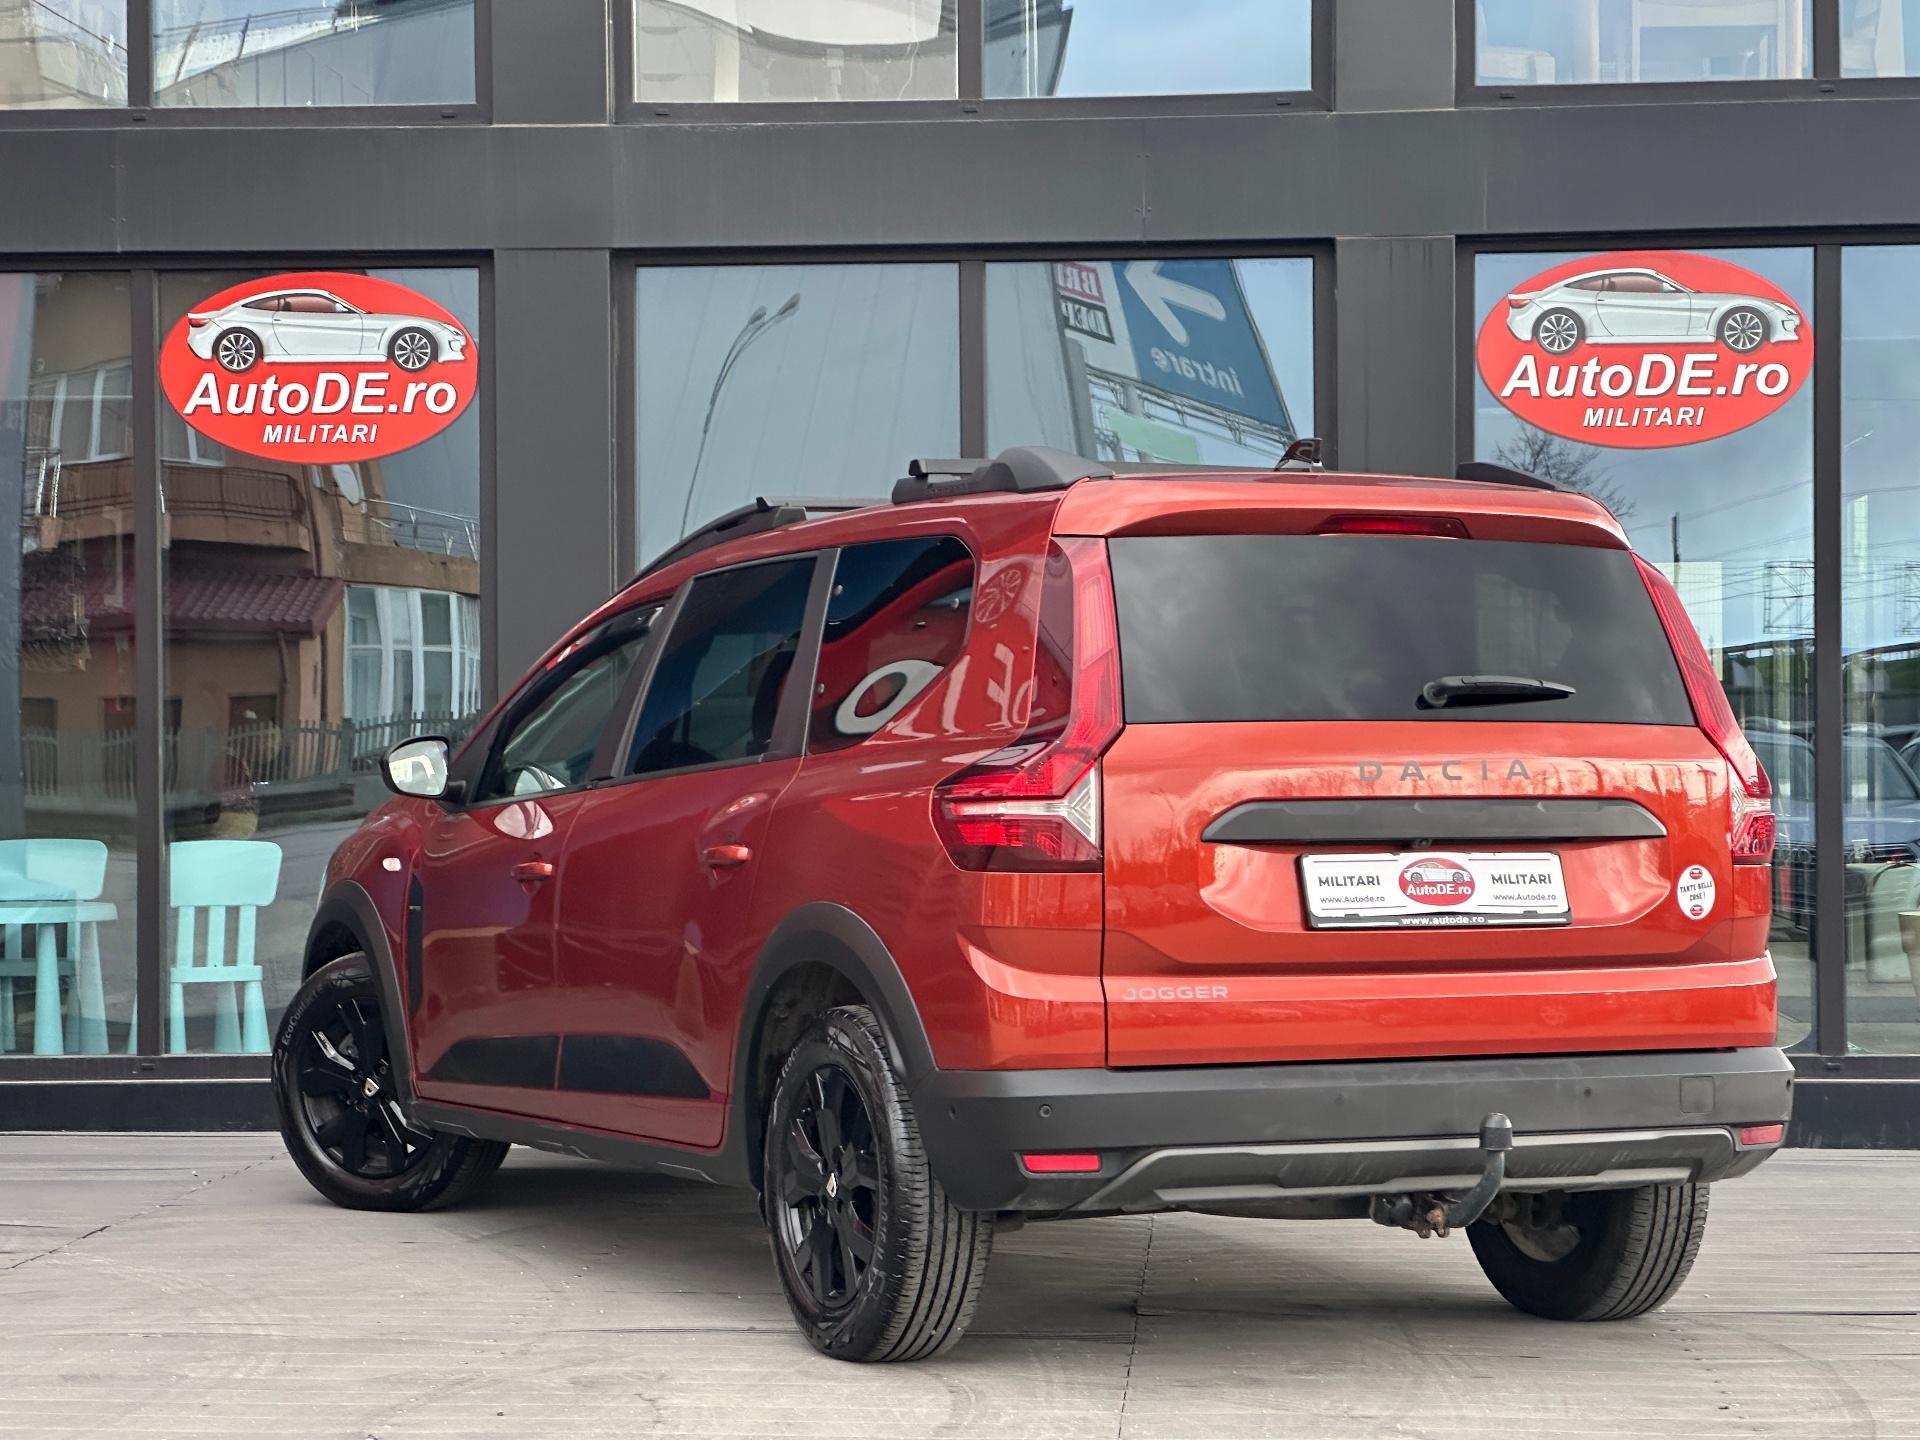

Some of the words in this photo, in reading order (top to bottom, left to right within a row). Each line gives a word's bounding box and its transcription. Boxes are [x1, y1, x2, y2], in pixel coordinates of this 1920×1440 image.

[1500, 353, 1789, 398] AutoDE.ro
[183, 372, 457, 415] AutoDE.ro
[1583, 406, 1705, 428] MILITARI
[262, 423, 378, 444] MILITARI
[1359, 760, 1531, 781] DACIA
[1318, 875, 1381, 887] MILITARI
[1491, 873, 1552, 885] MILITARI
[1406, 883, 1472, 896] AutoDE.ro
[1320, 895, 1386, 904] www.Autode.ro
[1493, 893, 1557, 902] www.Autode.ro
[1401, 915, 1486, 926] www.autode.ro
[1122, 985, 1229, 1001] JOGGER
